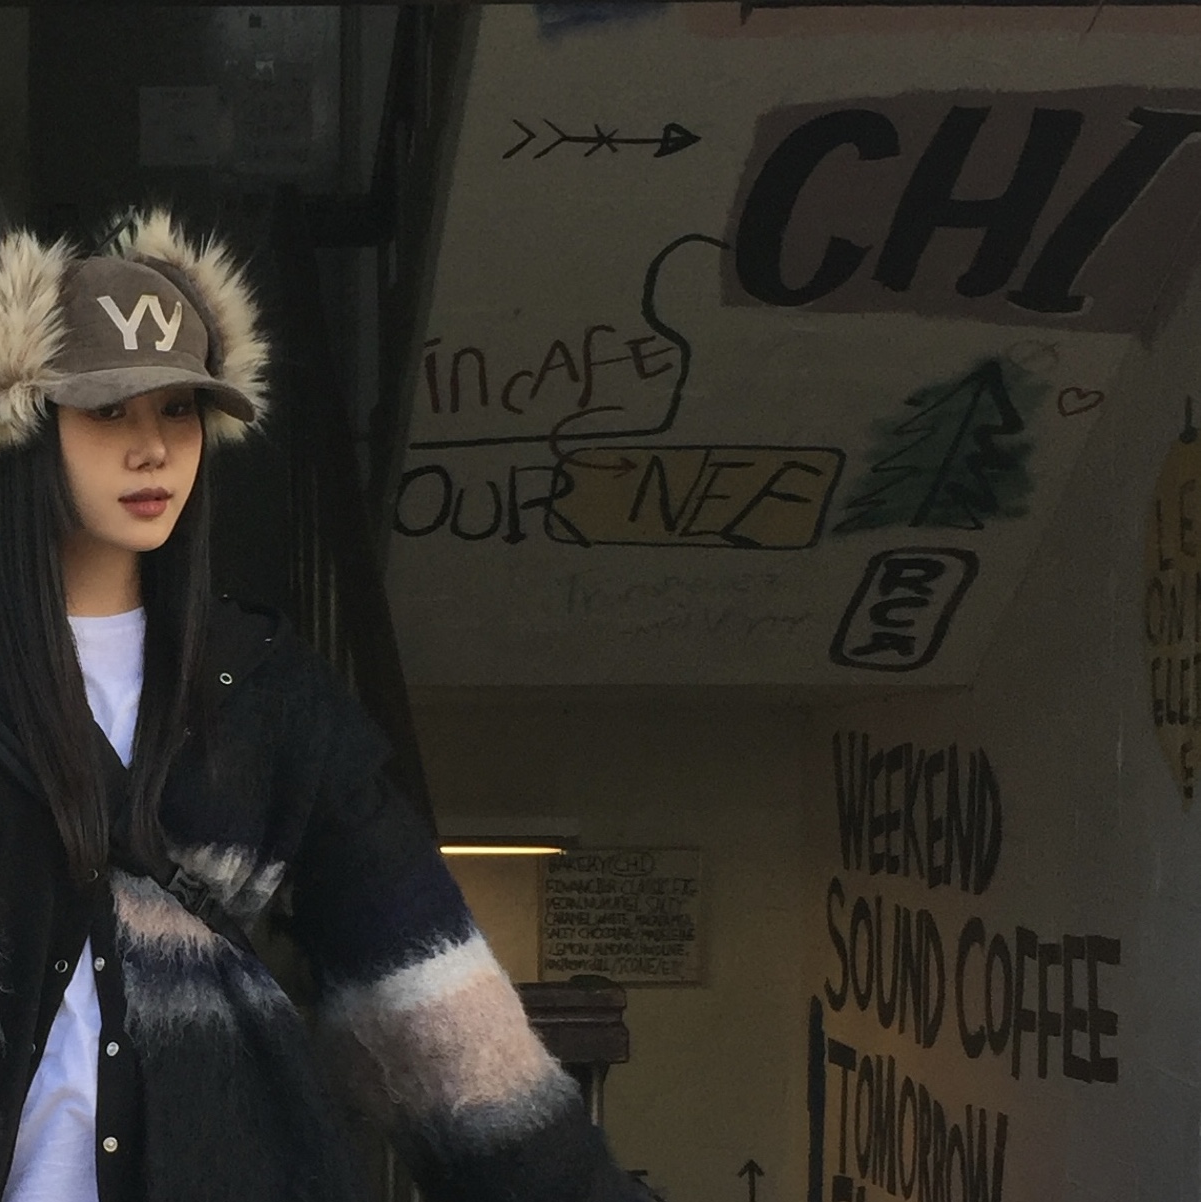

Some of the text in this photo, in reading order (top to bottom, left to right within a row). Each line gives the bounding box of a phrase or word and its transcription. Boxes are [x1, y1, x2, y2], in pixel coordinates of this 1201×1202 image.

[831, 731, 1003, 895] WEEKEND
[824, 876, 1121, 1083] SOUND COFFEE
